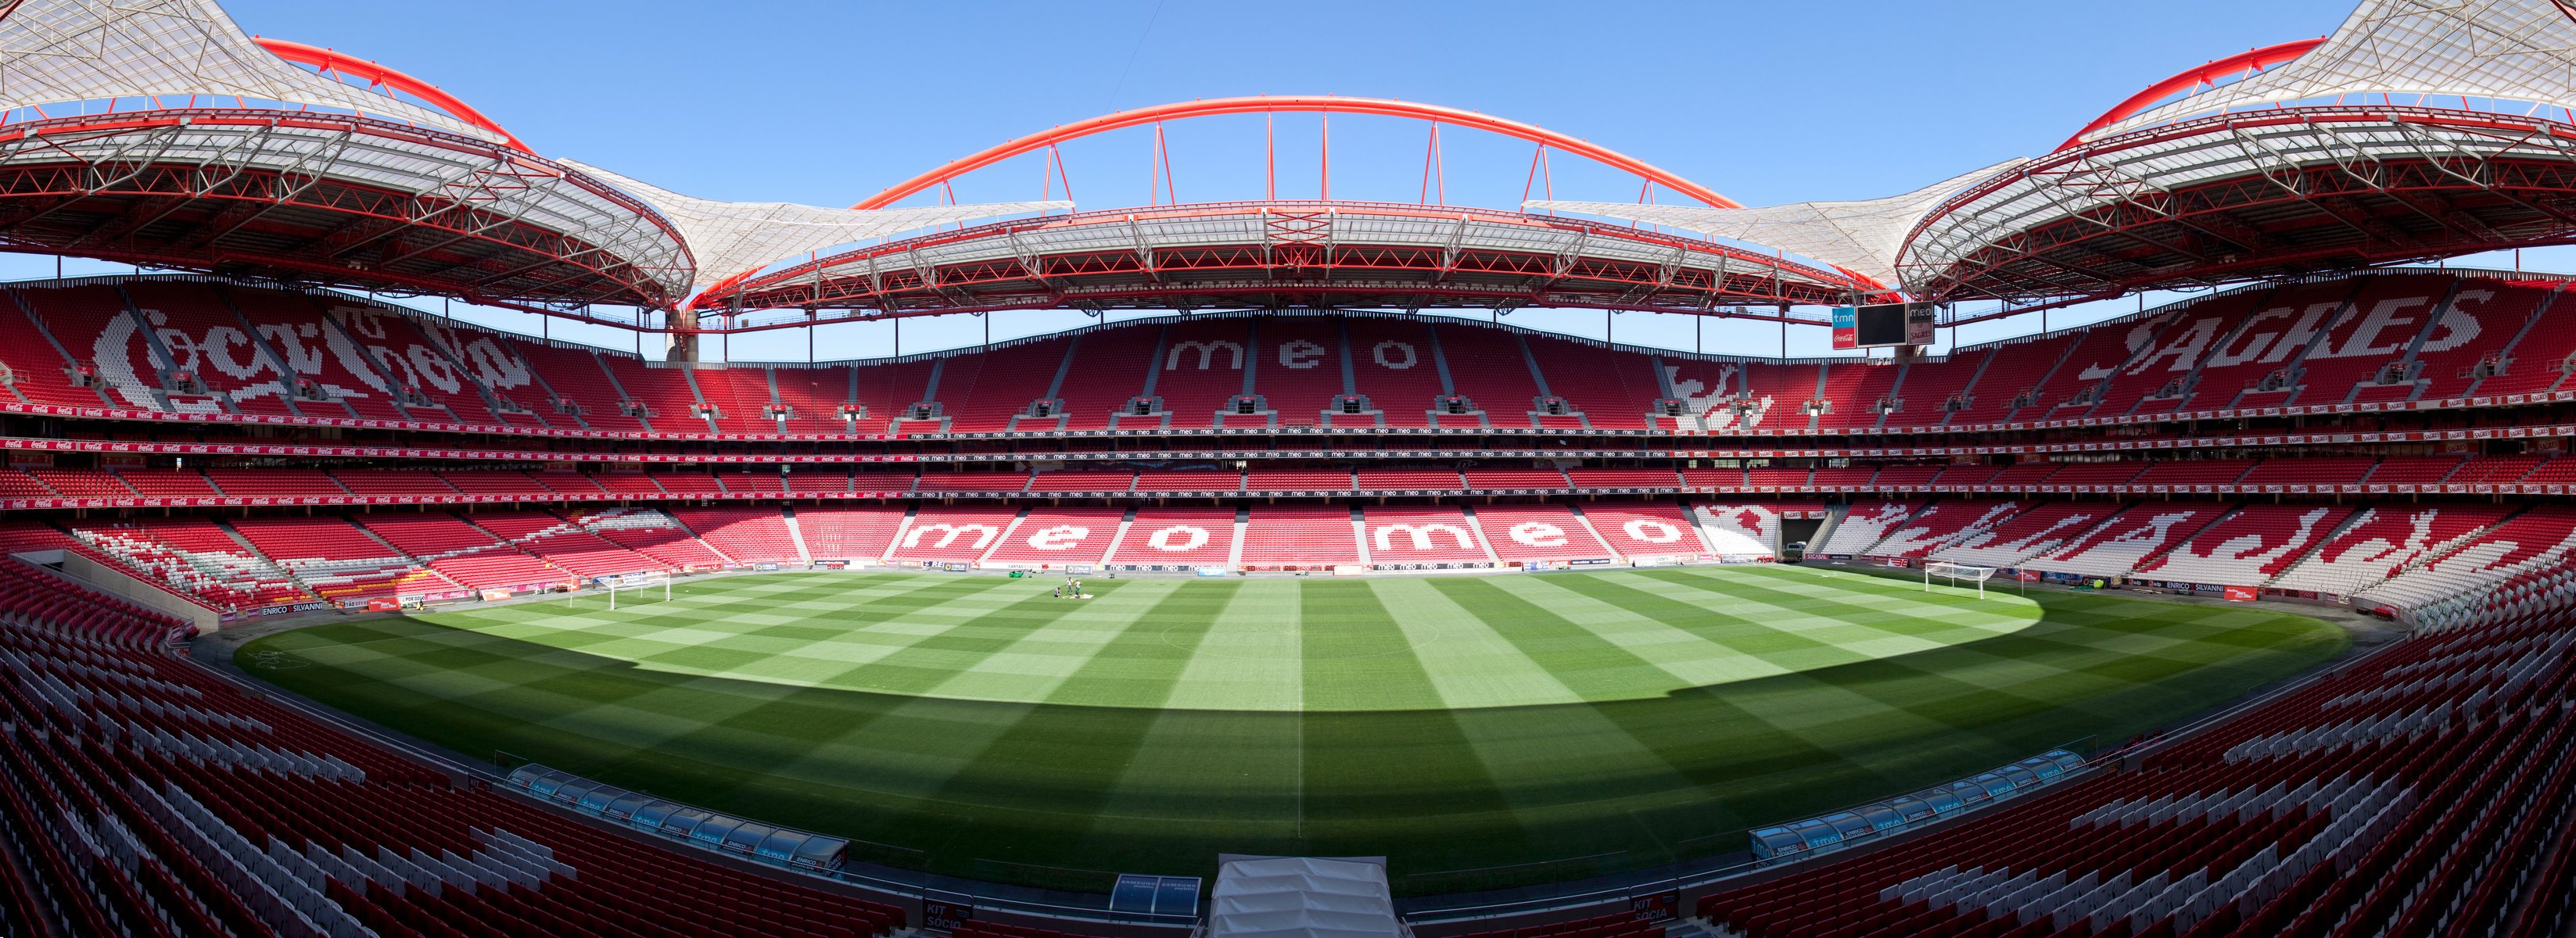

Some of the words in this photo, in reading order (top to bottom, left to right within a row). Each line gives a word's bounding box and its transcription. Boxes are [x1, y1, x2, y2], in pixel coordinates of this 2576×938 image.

[1910, 308, 1932, 317] meo
[1834, 313, 1853, 323] tmn
[1910, 331, 1932, 340] SAGRES
[2079, 289, 2495, 381] SAGRES
[2531, 393, 2547, 402] SAGRES
[2447, 443, 2465, 453] SAGRES
[2539, 440, 2558, 451] SAGRES
[2477, 485, 2492, 493] SAGRES
[1783, 510, 1801, 519] SAGRES
[1808, 510, 1825, 519] SAGRES
[263, 606, 288, 615] ENRICO
[293, 602, 323, 612] SILVANNI
[2042, 769, 2059, 779] tmn
[470, 778, 479, 787] KIT
[535, 785, 551, 795] tmn
[1993, 786, 2011, 796] tmn
[558, 792, 572, 800] ENRICO
[1966, 794, 1982, 803] ENRICO
[583, 800, 601, 811] tmn
[1939, 802, 1959, 813] tmn
[608, 807, 625, 817] ENRICO
[637, 815, 655, 827] tmn
[1878, 819, 1900, 830] tmn
[666, 824, 682, 833] ENRICO
[1846, 827, 1864, 836] ENRICO
[695, 832, 717, 844] tmn
[1813, 836, 1837, 847] tmn
[727, 840, 746, 850] ENRICO
[1752, 840, 1771, 858] tmn
[1777, 843, 1797, 853] ENRICO
[762, 848, 785, 861] tmn
[796, 857, 816, 866] ENRICO
[926, 903, 945, 915] KIT
[1634, 897, 1652, 911] KIT
[1634, 908, 1667, 921] SÓCIA
[926, 915, 962, 929] SÓCIO
